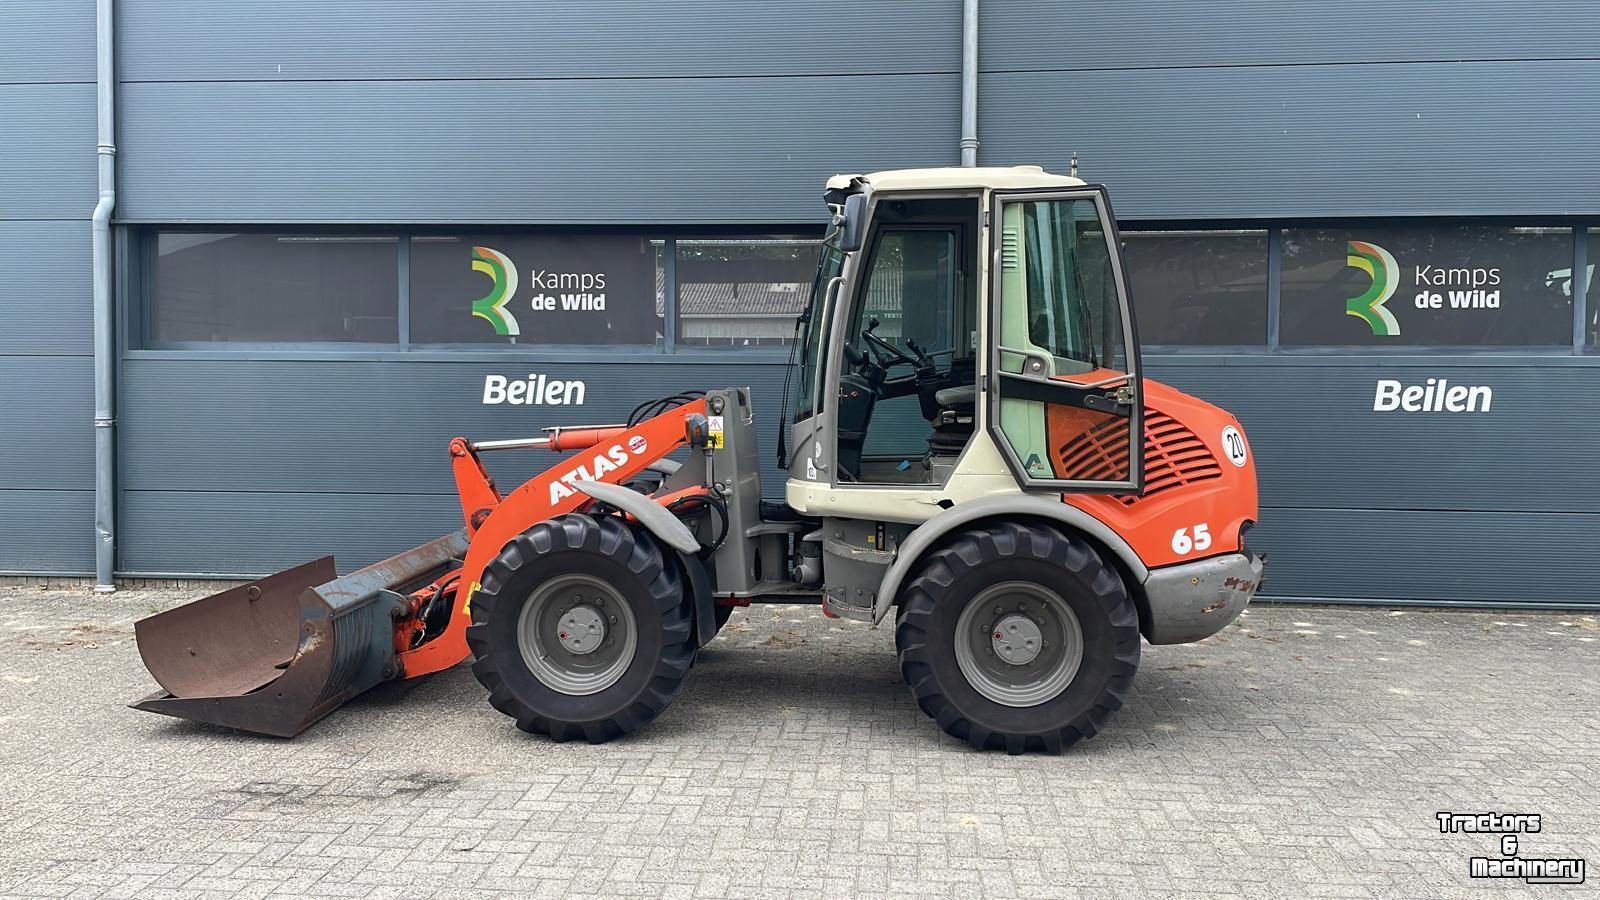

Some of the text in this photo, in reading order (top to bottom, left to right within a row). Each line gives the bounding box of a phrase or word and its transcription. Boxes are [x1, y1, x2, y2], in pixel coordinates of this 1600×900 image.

[531, 269, 606, 291] Kamps
[1415, 264, 1501, 288] Kamps
[531, 293, 606, 311] de Wild
[1414, 289, 1501, 309] de Wild
[482, 373, 586, 406] Beilen
[1373, 378, 1493, 413] Beilen
[1227, 432, 1244, 459] 20
[549, 444, 629, 507] ATLAS
[1171, 522, 1213, 556] 65
